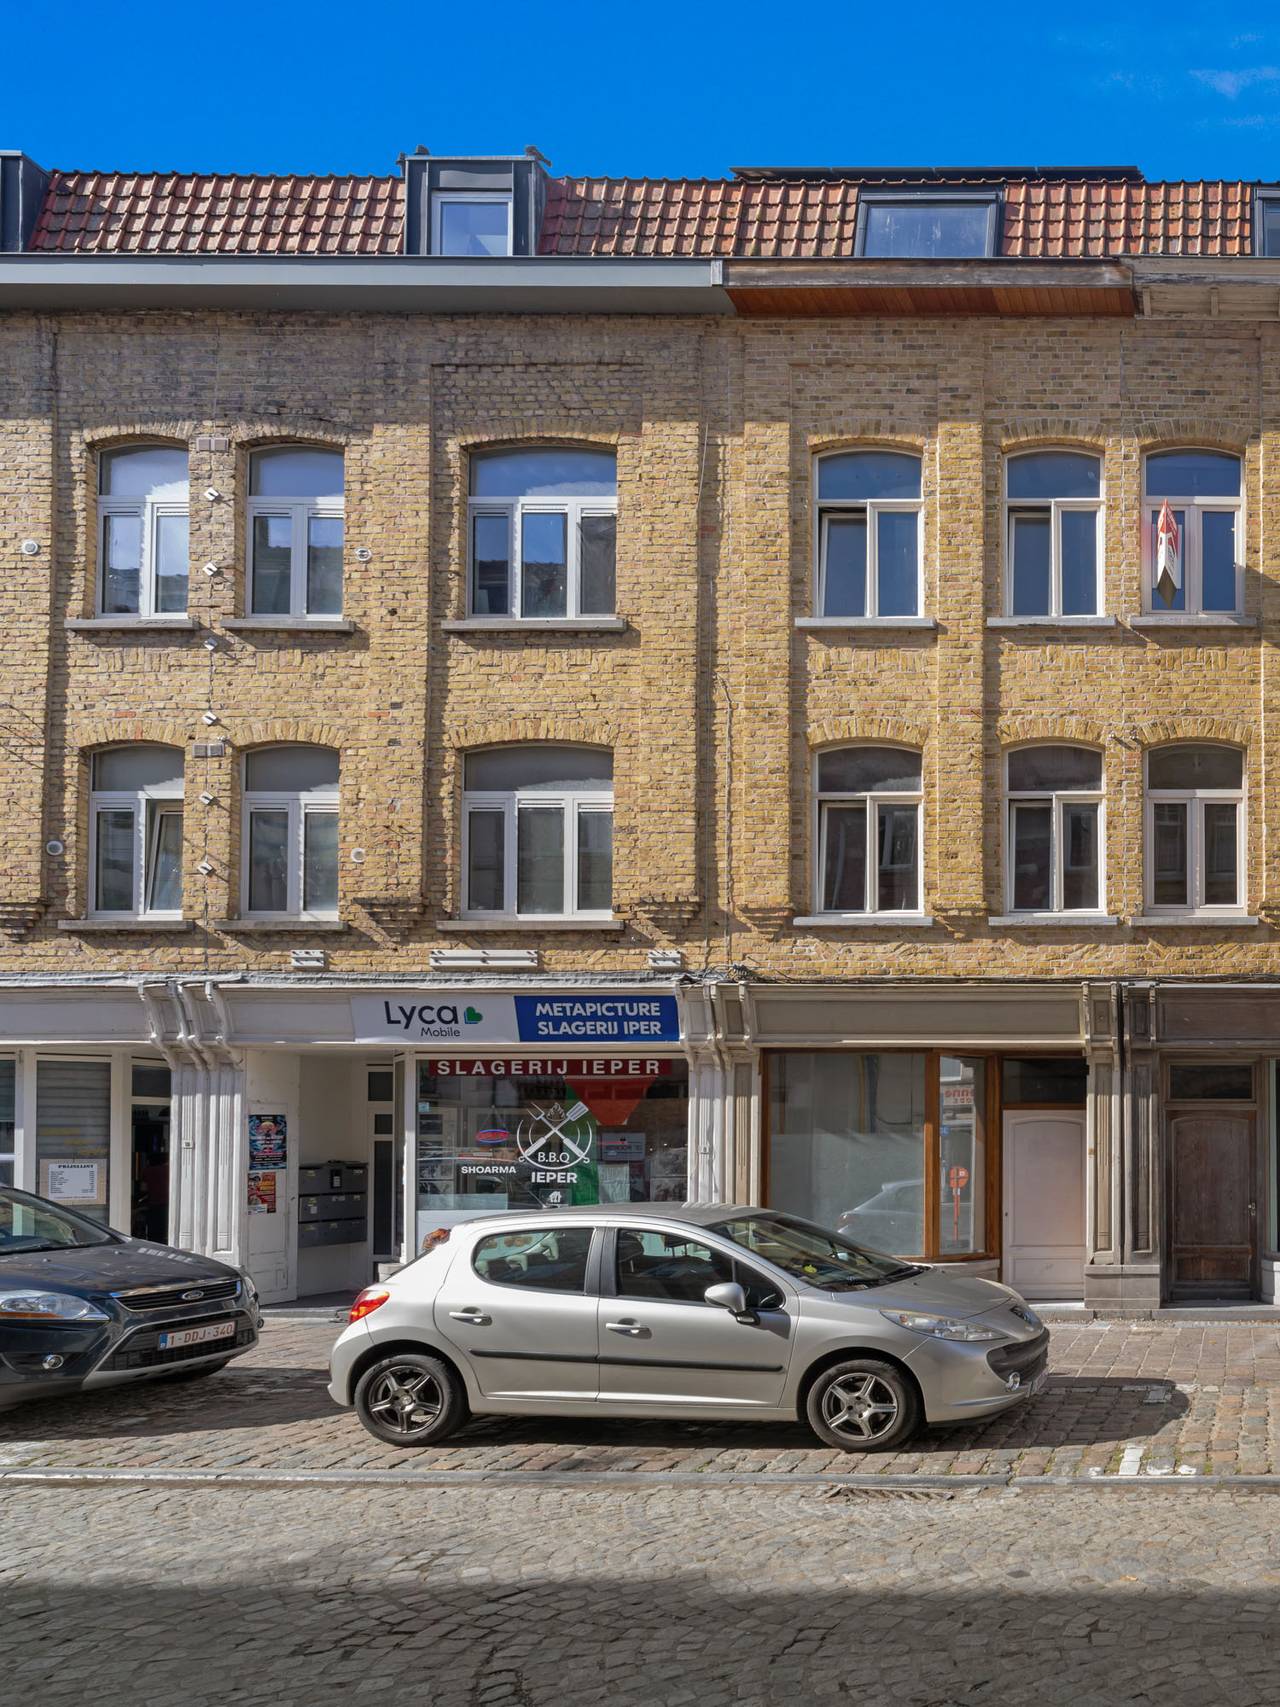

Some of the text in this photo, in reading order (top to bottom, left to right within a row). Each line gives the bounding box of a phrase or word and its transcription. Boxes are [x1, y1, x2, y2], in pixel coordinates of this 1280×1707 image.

[384, 1001, 459, 1030] Lyca
[536, 1002, 661, 1017] METAPICTURE
[420, 1026, 461, 1038] Mobile
[537, 1021, 662, 1036] SLAGERIJ IPER
[437, 1060, 660, 1075] SLAGERIJ IEPER
[537, 1151, 571, 1164] B.B.Q
[461, 1165, 517, 1175] SHOARMA
[531, 1171, 578, 1184] IEPER
[169, 1323, 234, 1346] 1-DDJ-340
